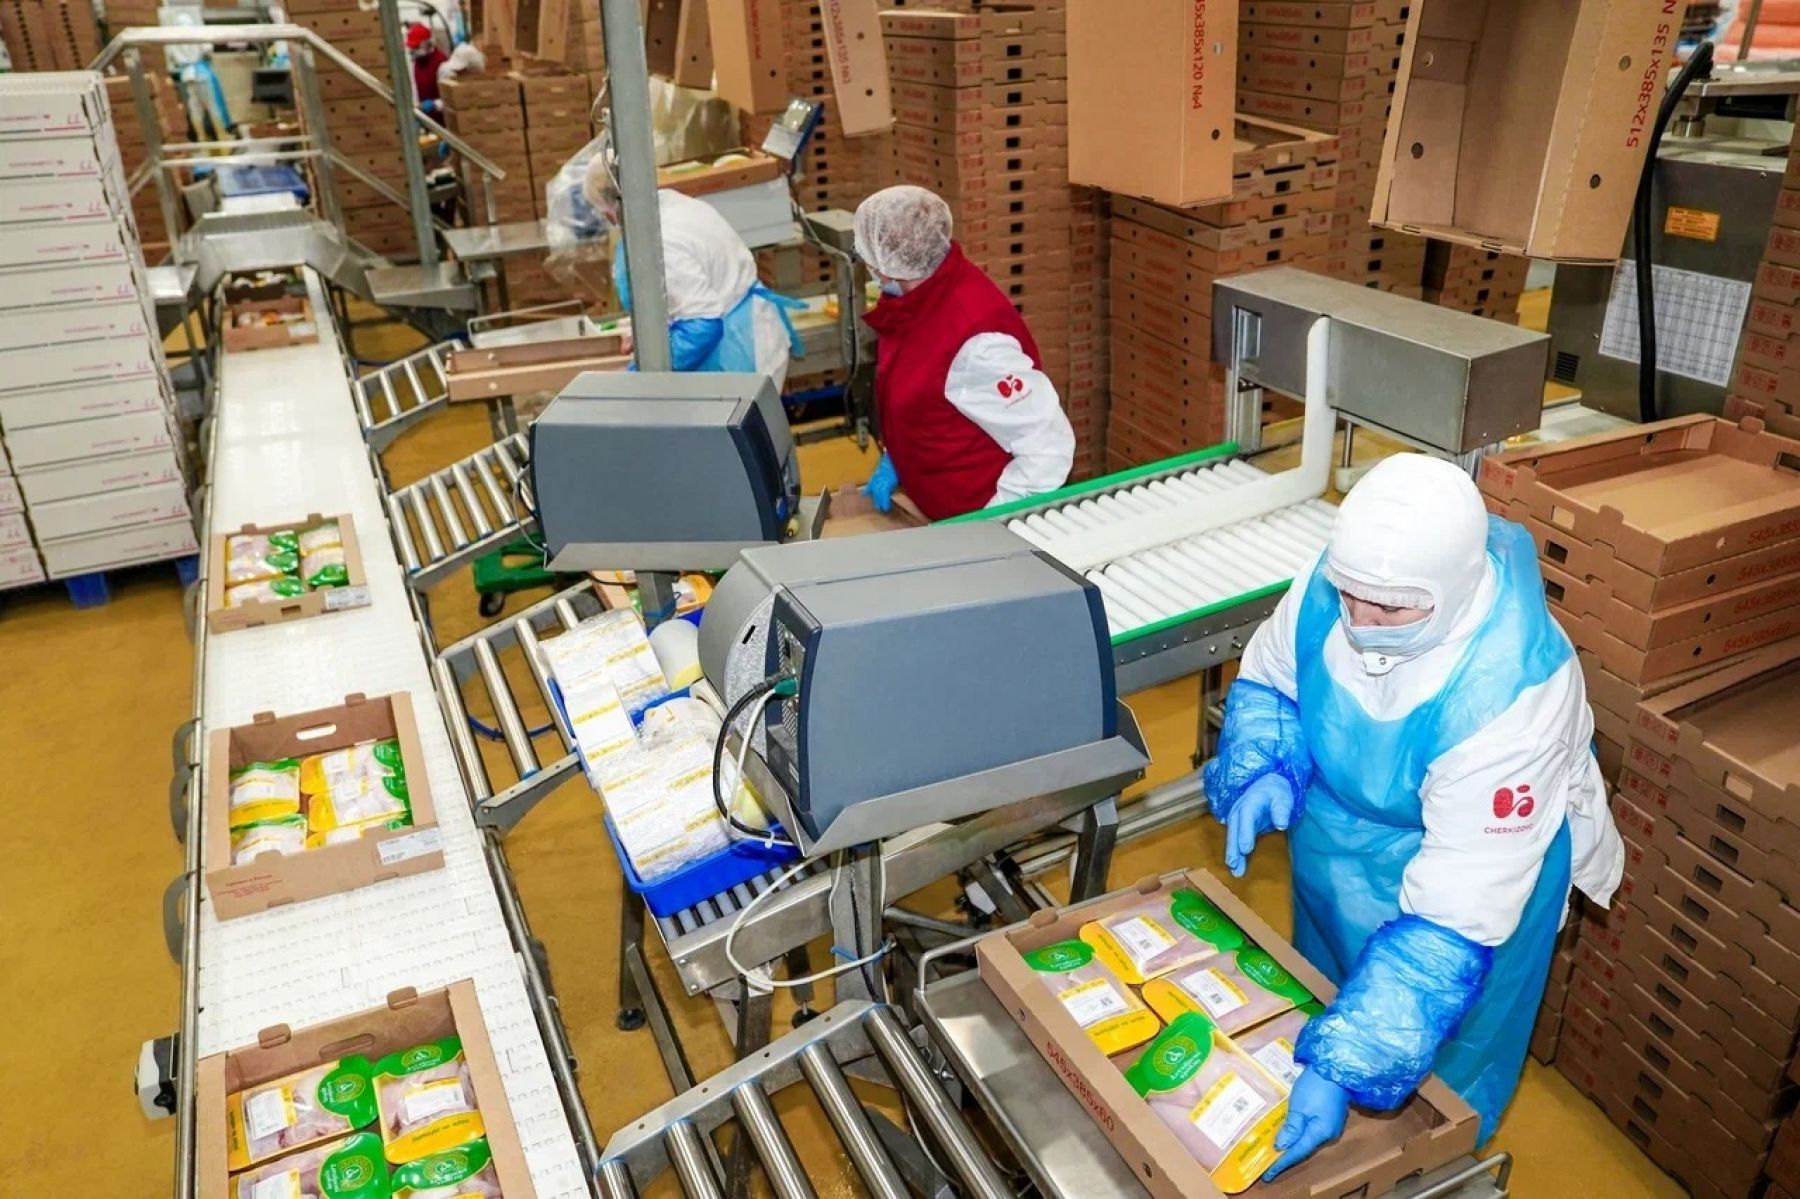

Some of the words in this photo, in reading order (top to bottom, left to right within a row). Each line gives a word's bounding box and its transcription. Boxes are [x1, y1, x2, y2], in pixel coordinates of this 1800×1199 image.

[1193, 0, 1206, 80] 5x385x120
[1626, 23, 1670, 148] 512x385x135
[1046, 1041, 1115, 1132] 545x385x60
